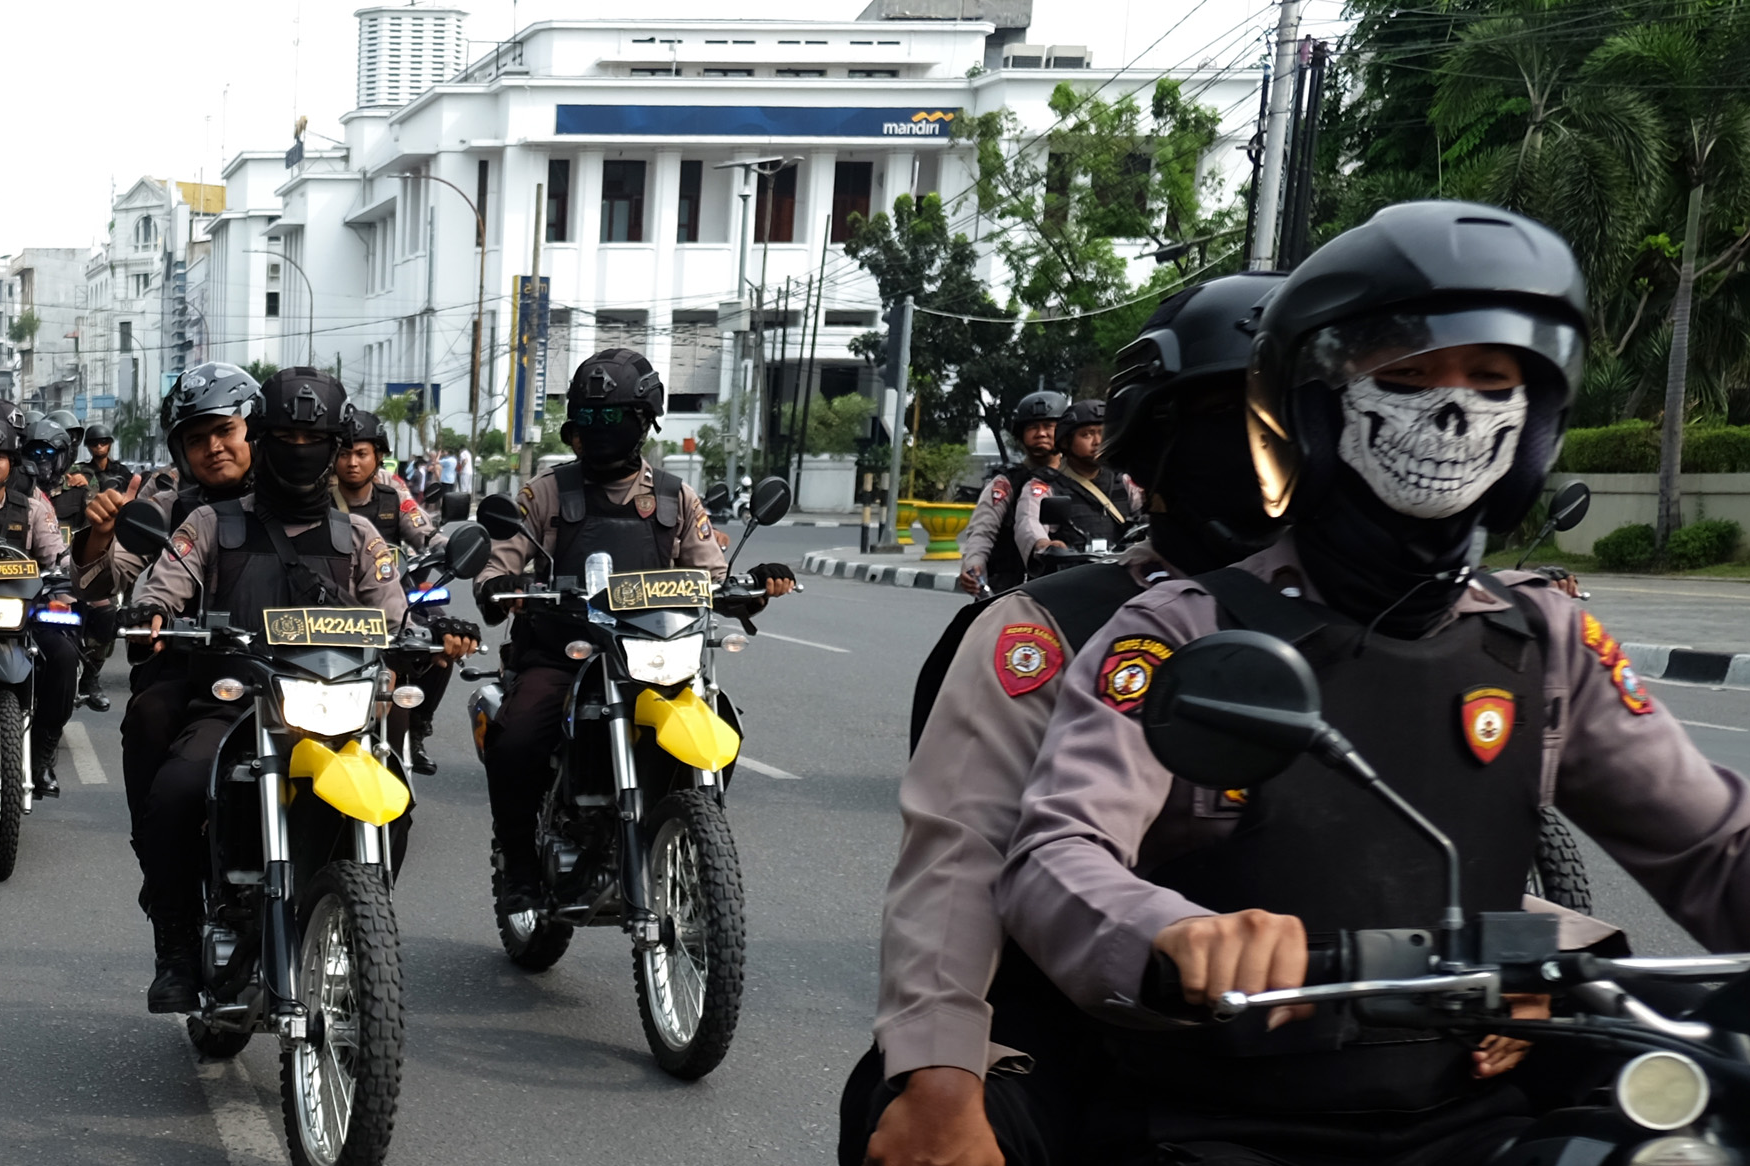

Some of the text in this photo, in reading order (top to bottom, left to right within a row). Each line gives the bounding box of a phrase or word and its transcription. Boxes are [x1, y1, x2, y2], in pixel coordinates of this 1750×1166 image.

[883, 119, 940, 136] mandiri
[524, 282, 548, 294] am
[645, 579, 710, 598] 142242-II
[308, 616, 384, 636] 142244-II
